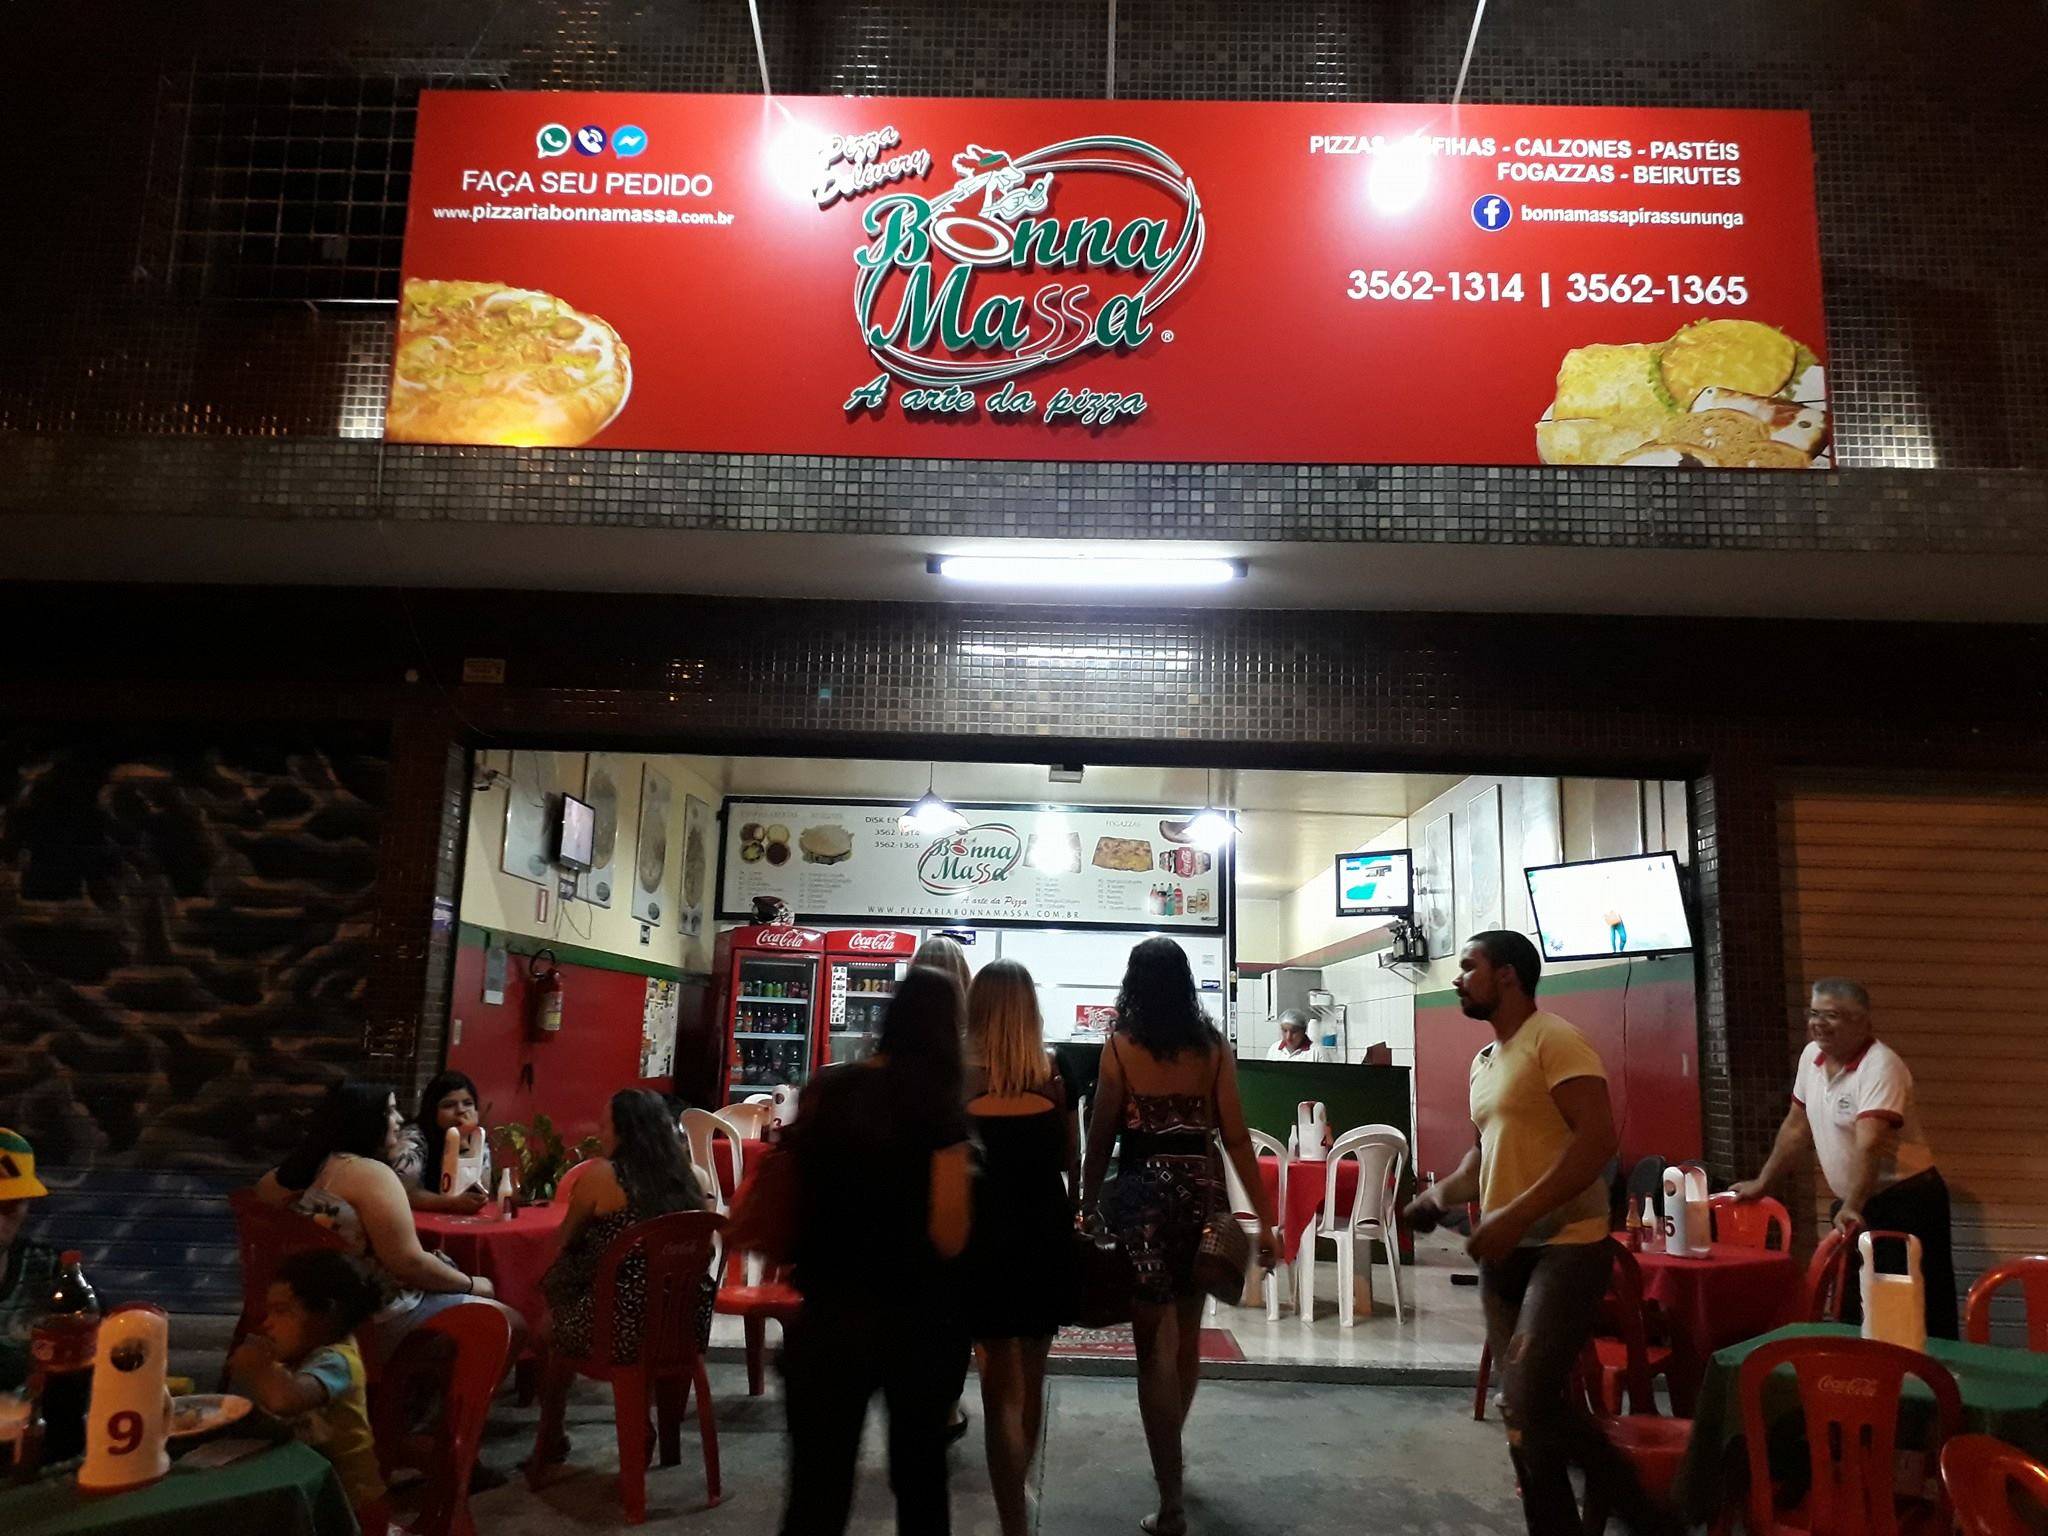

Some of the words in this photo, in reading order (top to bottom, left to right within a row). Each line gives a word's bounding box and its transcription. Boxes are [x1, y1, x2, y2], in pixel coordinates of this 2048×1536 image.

[1515, 138, 1632, 159] CALZONES
[1650, 139, 1740, 161] PASTÉIS
[462, 170, 535, 198] FAÇA
[540, 172, 598, 195] SEU
[605, 173, 713, 197] PEDIDO
[1498, 162, 1615, 183] FOGAZZAS
[1633, 165, 1741, 186] BEIRUTES
[432, 203, 735, 225] www.pizzariabonnamassa.com.br
[1520, 204, 1745, 229] bonnamassapirassununga
[855, 193, 1173, 270] Bonna
[1346, 269, 1526, 302] 3562-1314
[1566, 273, 1749, 306] 3562-1365
[868, 264, 1154, 360] Massa
[842, 373, 892, 415] A
[899, 383, 977, 413] arte
[985, 381, 1037, 413] da
[1043, 389, 1148, 424] pizza
[929, 838, 1012, 859] Bonna
[931, 856, 1009, 884] Massa
[106, 1410, 144, 1456] 9
